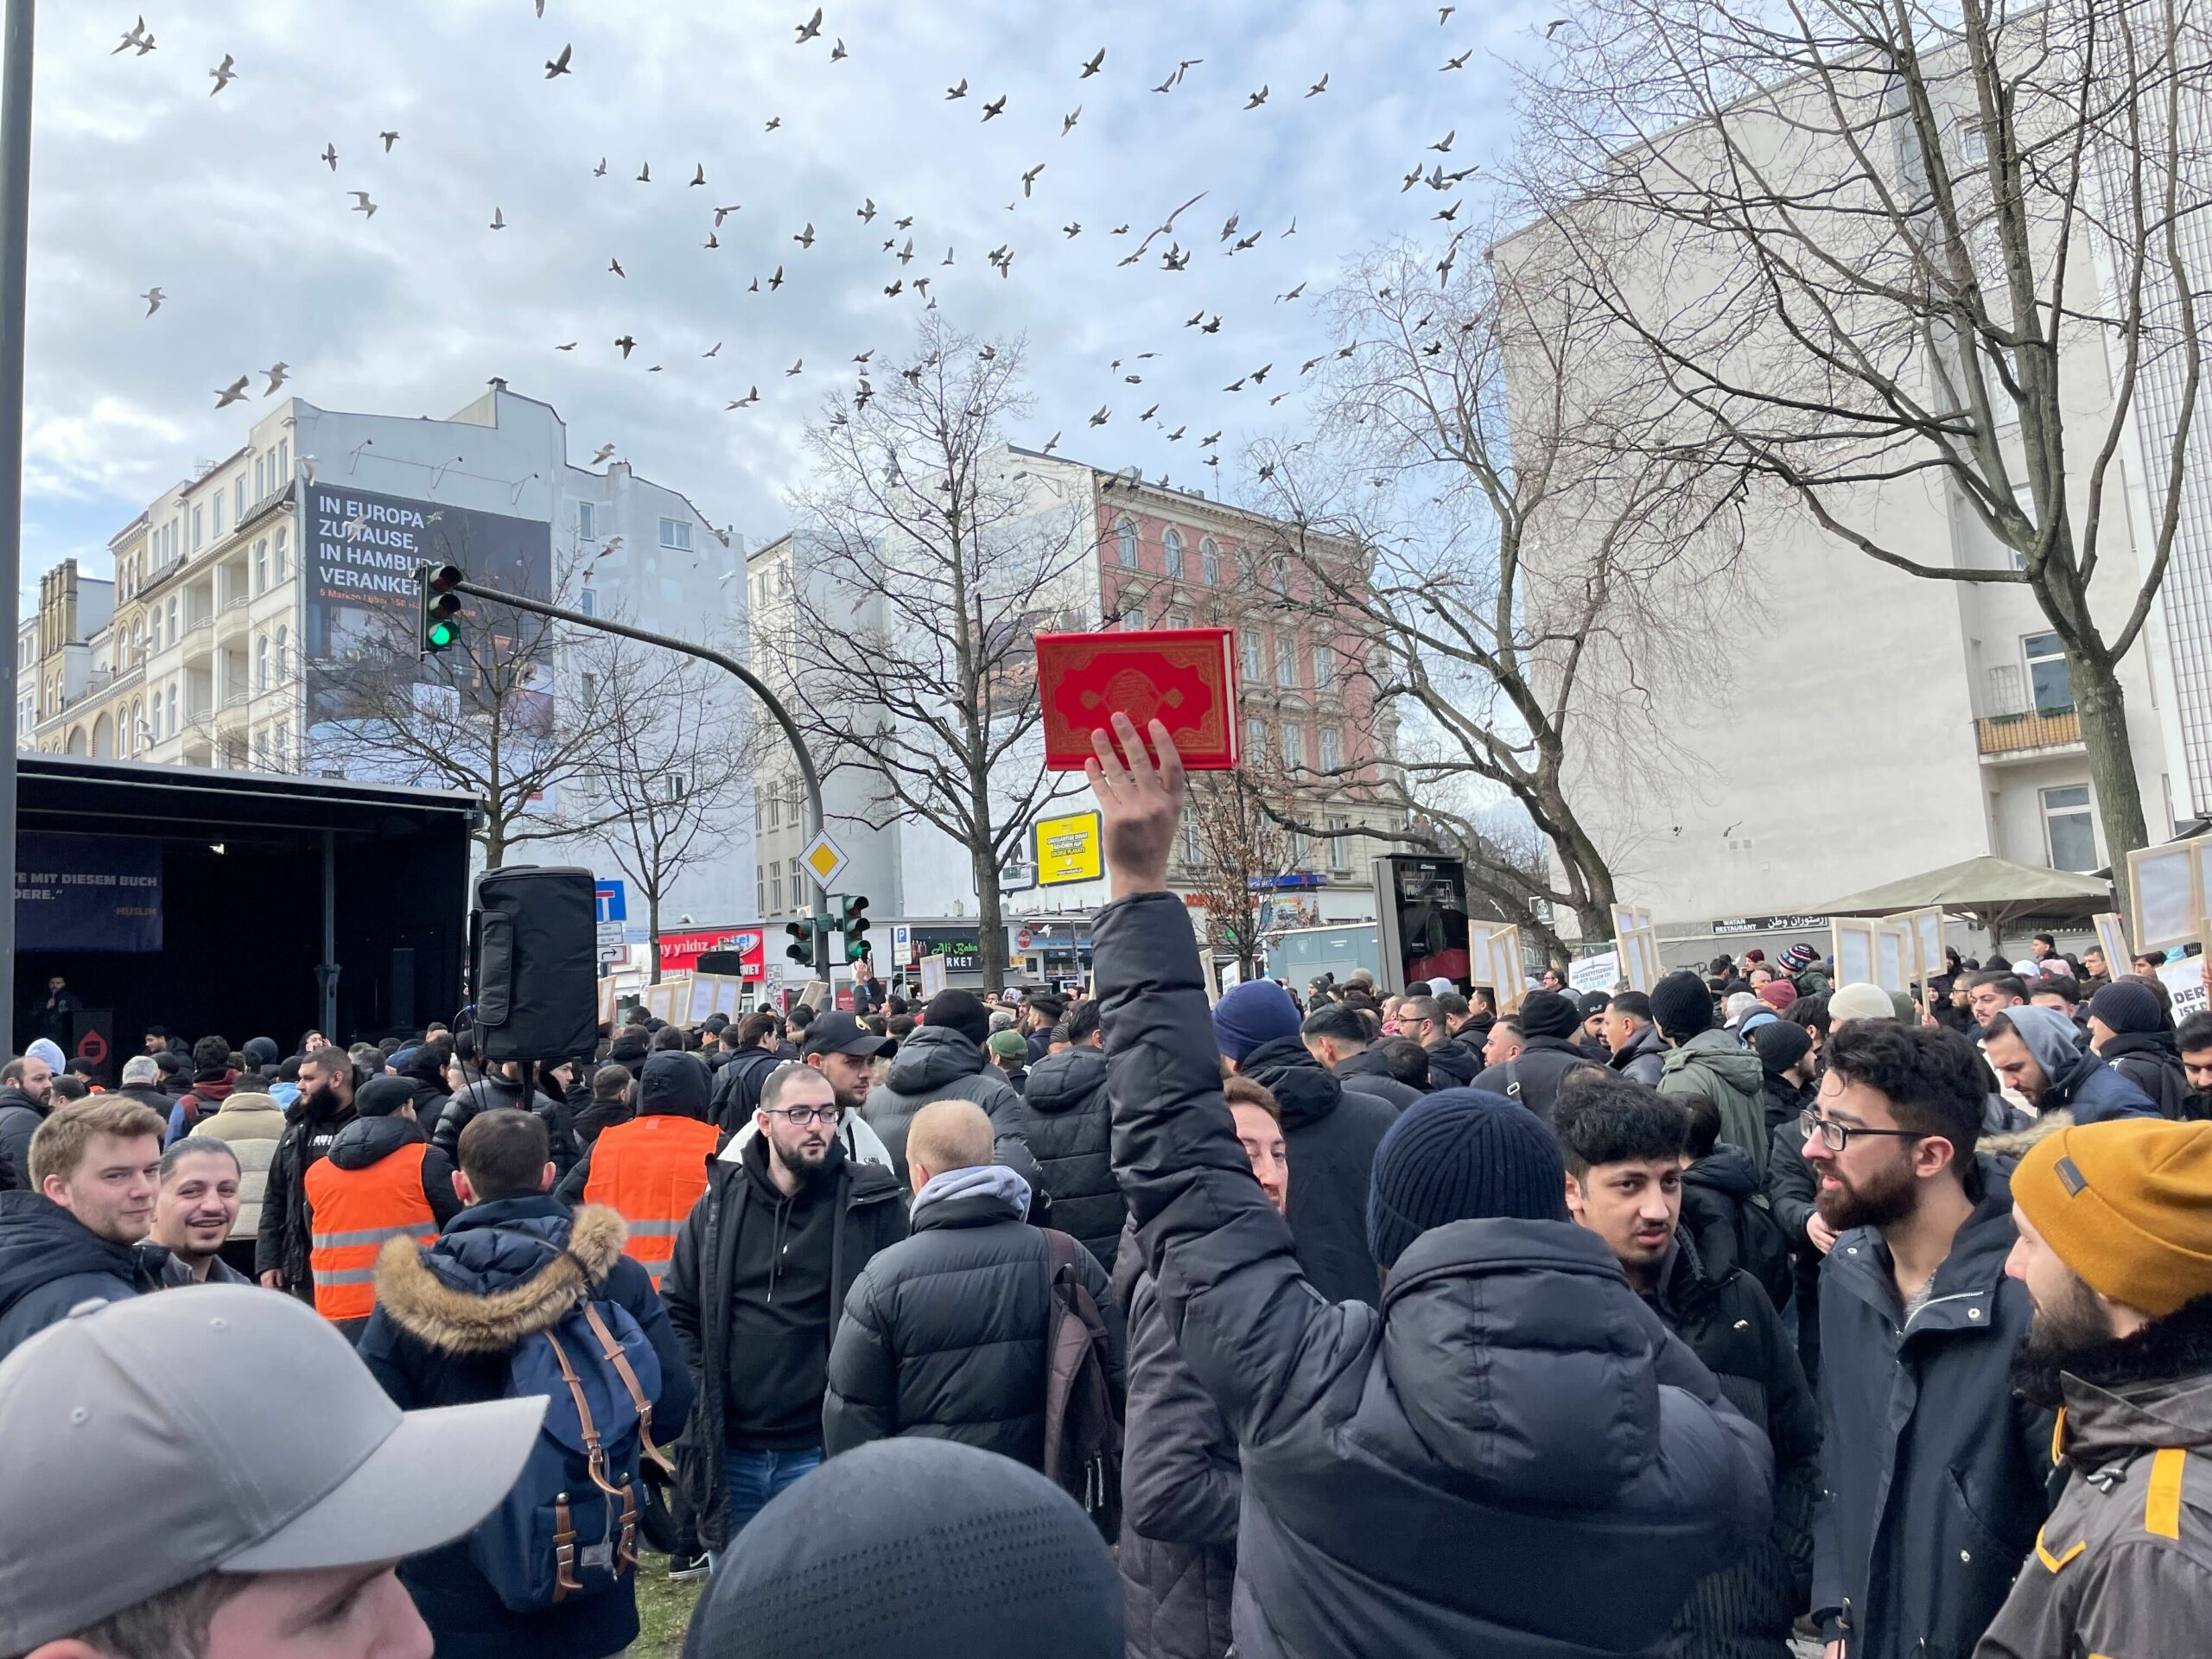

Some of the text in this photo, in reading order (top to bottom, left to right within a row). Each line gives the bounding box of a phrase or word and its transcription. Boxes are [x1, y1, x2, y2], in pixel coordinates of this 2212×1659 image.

[319, 495, 424, 529] IN EUROPA
[320, 543, 446, 572] IN HAMBU
[31, 874, 58, 884] MIT
[61, 874, 116, 886] DIESEM
[119, 876, 157, 887] BUCH
[1715, 924, 1757, 932] RESTAURANT
[931, 943, 978, 955] Ali Baba
[946, 957, 973, 967] RKET
[741, 963, 760, 976] NET
[2173, 986, 2205, 1004] DER
